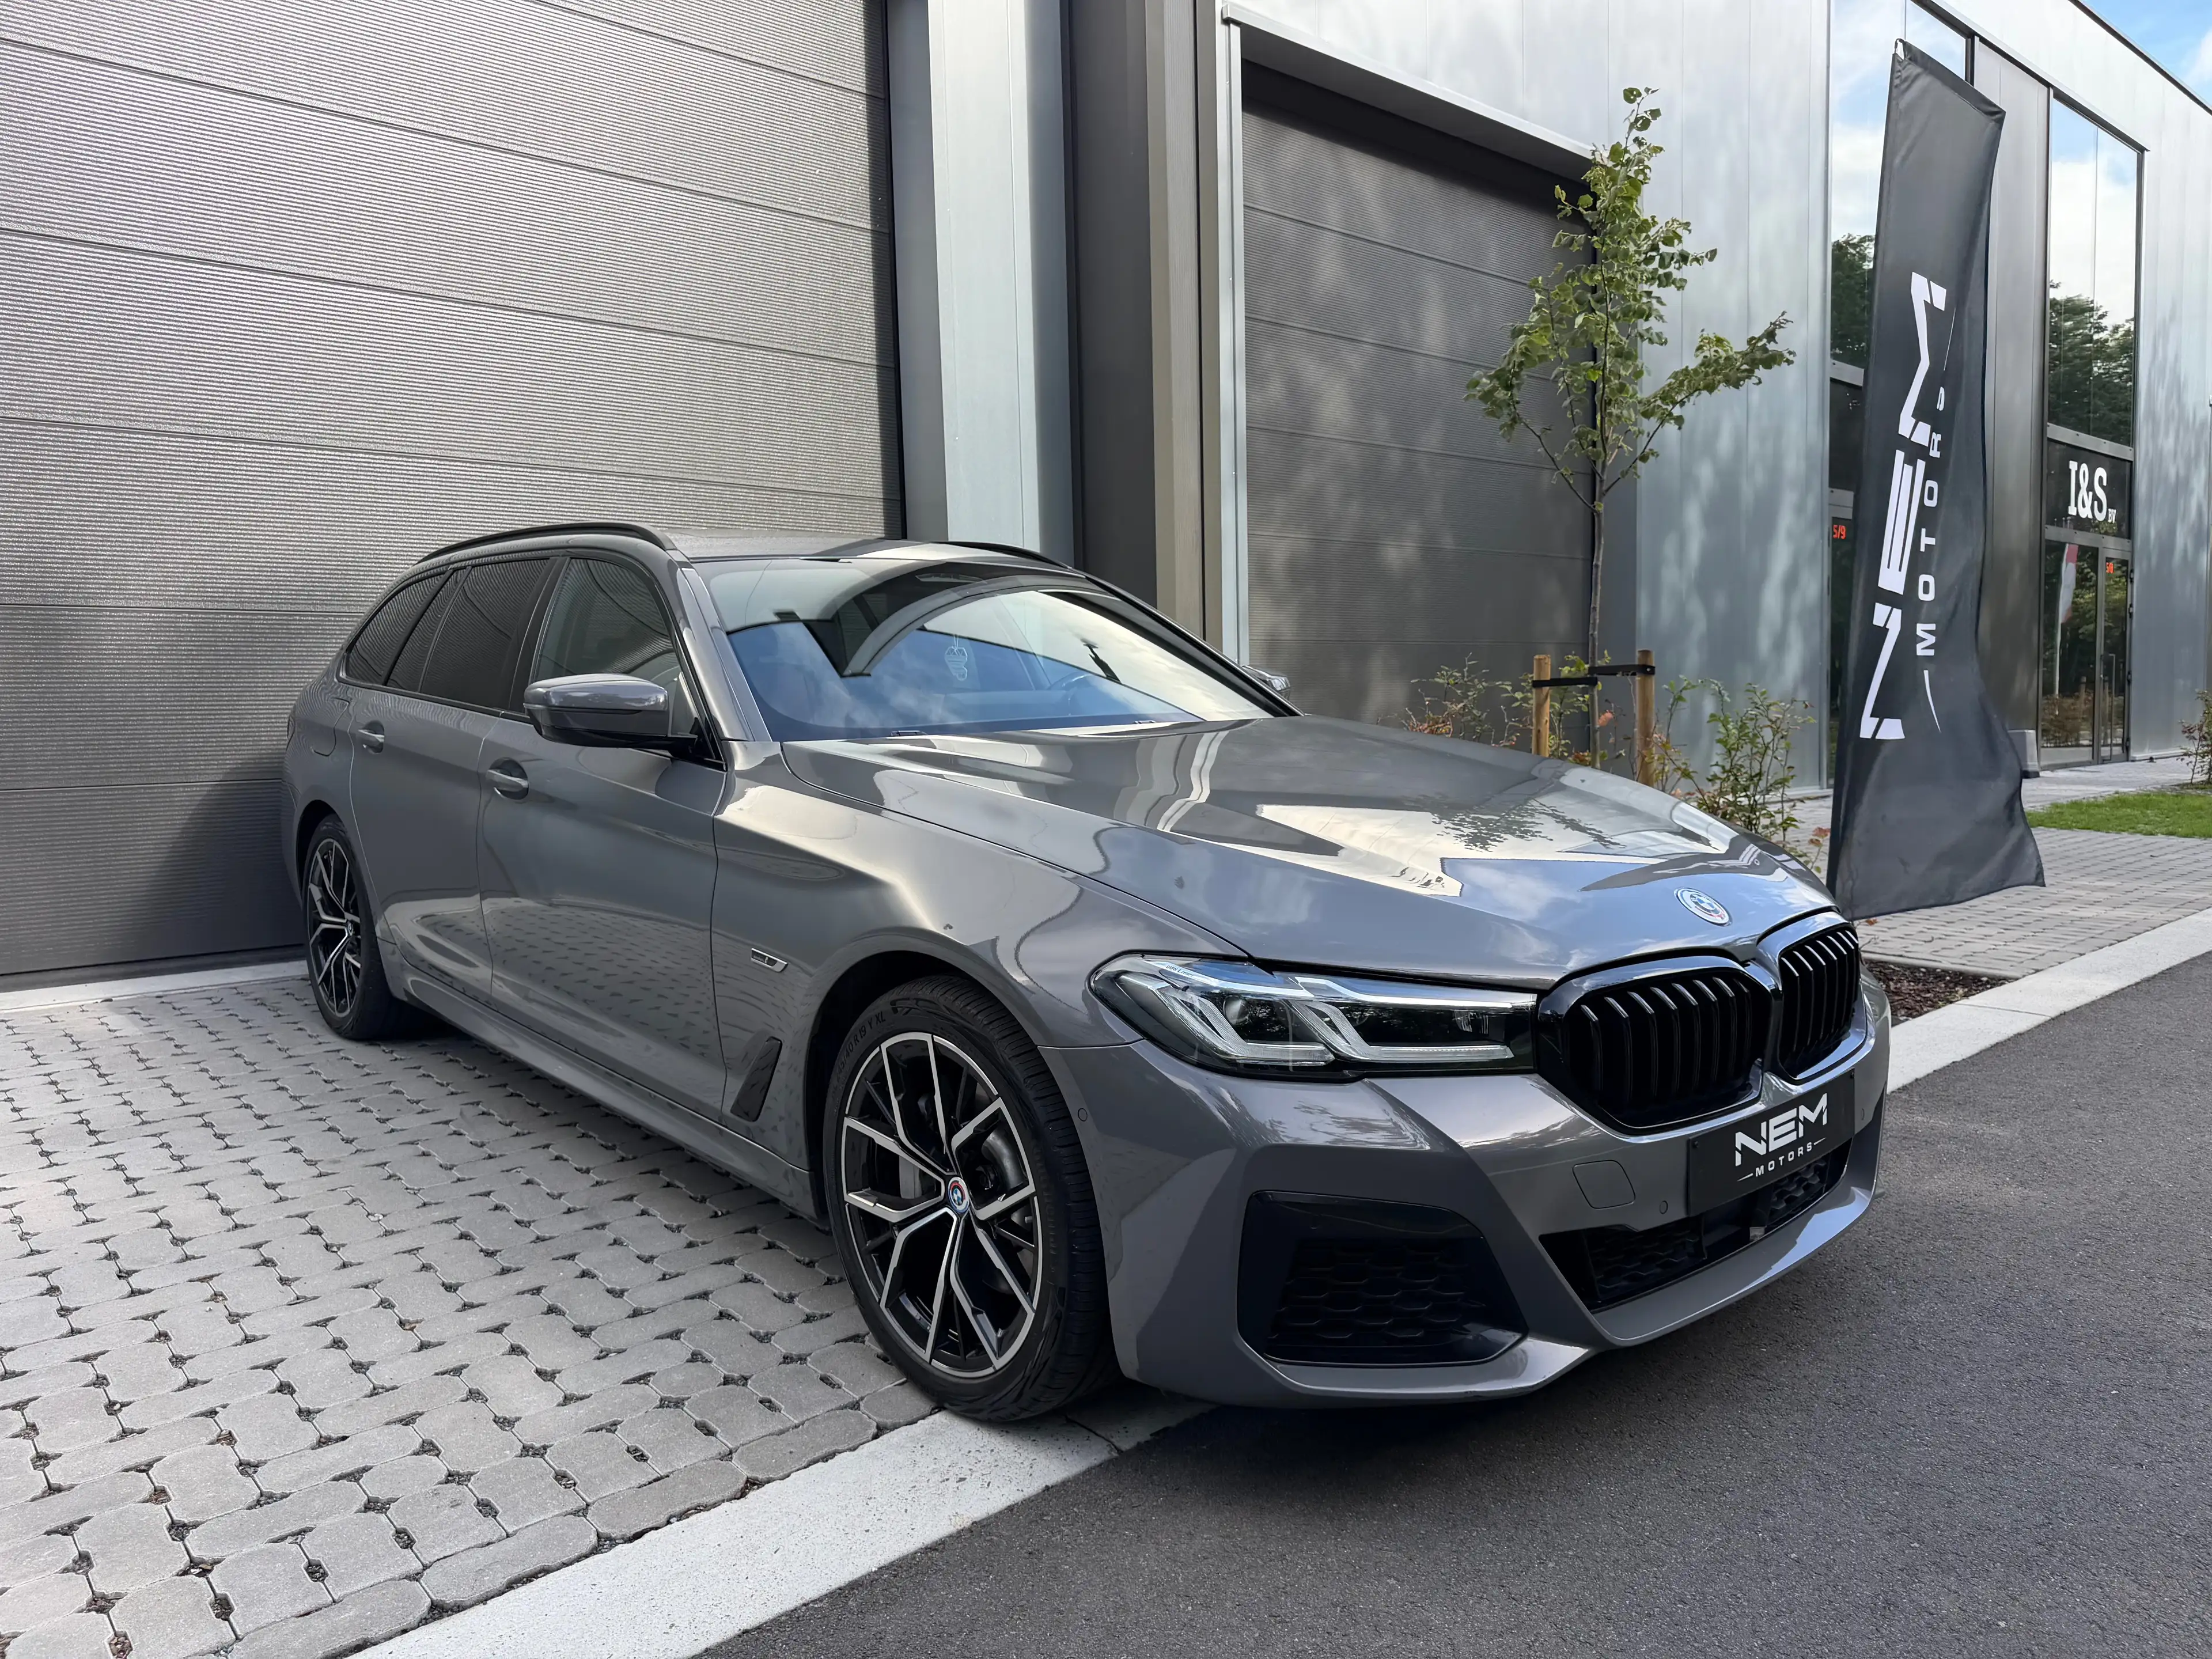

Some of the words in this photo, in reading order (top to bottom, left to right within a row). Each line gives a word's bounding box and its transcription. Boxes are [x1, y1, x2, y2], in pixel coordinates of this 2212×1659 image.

[1859, 272, 1946, 740] NEM
[1832, 524, 1846, 540] 5/9
[875, 1011, 886, 1026] XL
[1735, 1093, 1827, 1166] NEM
[1756, 1142, 1812, 1177] MOTORS
